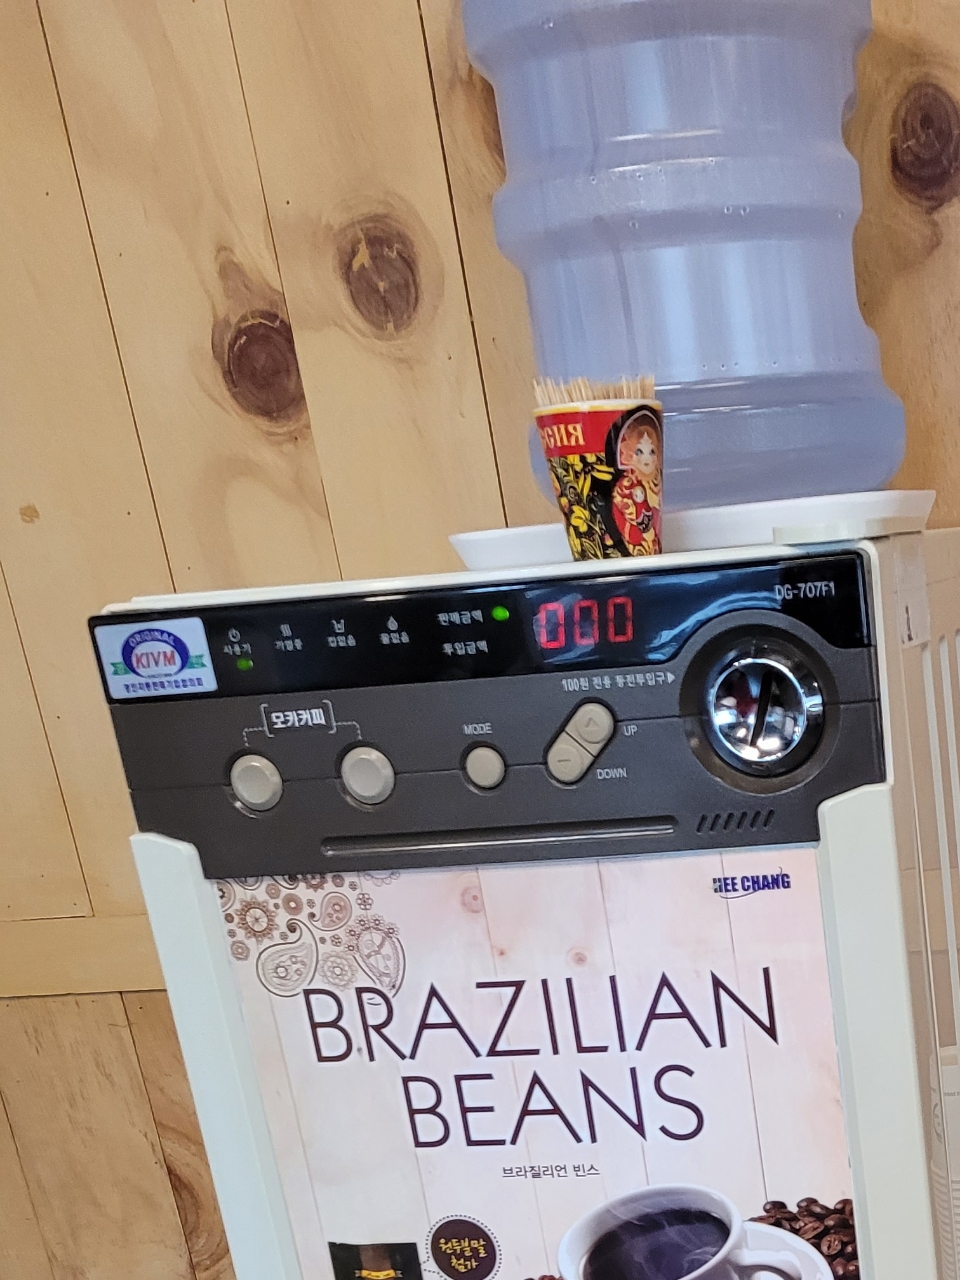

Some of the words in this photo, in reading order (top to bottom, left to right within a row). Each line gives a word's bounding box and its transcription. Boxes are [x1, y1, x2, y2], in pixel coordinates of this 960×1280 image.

[774, 581, 835, 600] DG-707F1
[538, 596, 634, 649] 000
[135, 650, 176, 669] KIVM
[270, 707, 327, 729] 모카커피
[463, 722, 493, 735] MODE
[623, 725, 638, 736] UP
[596, 768, 627, 779] DOWN
[740, 873, 791, 892] CHANG
[302, 966, 779, 1063] BRAZILIAN
[401, 1064, 704, 1148] BEANS
[502, 1163, 569, 1179] 브라질리언
[572, 1163, 601, 1178] 빈스
